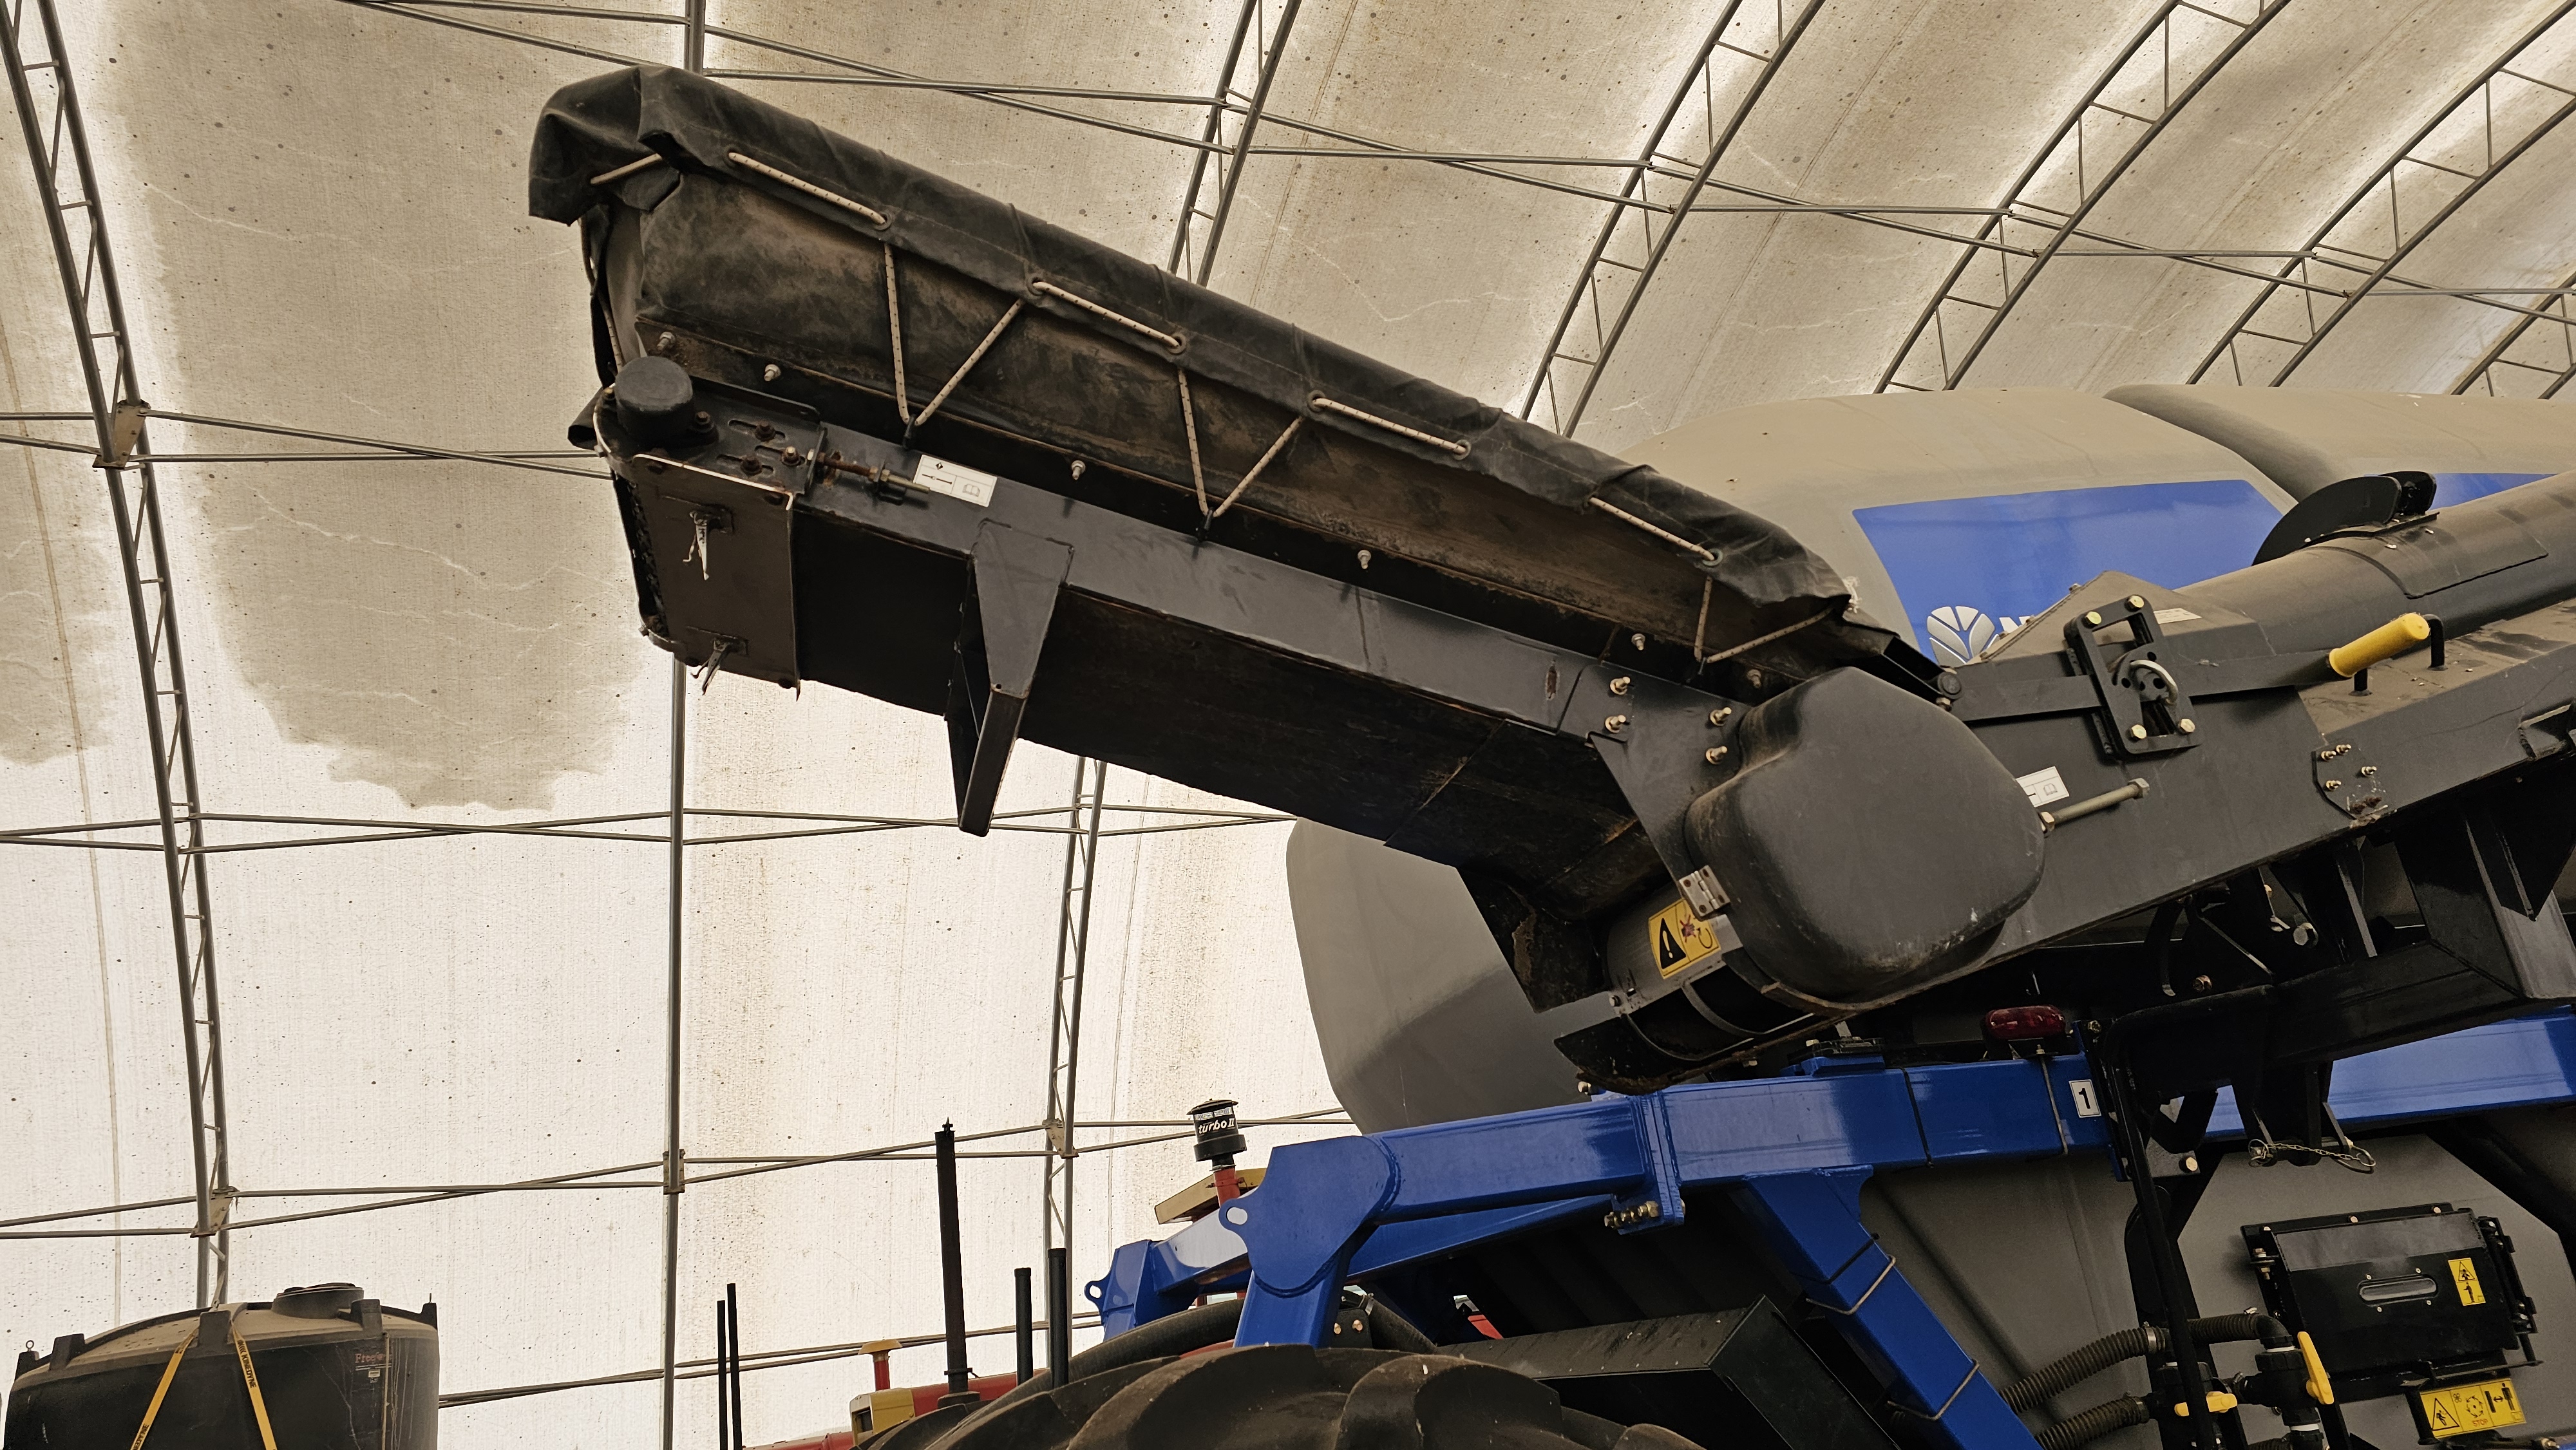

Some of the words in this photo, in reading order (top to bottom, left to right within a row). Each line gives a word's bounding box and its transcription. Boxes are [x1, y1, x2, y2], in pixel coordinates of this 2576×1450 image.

[2079, 1088, 2090, 1109] 1
[1198, 1120, 1227, 1134] turbo
[2472, 1418, 2488, 1427] STOP
